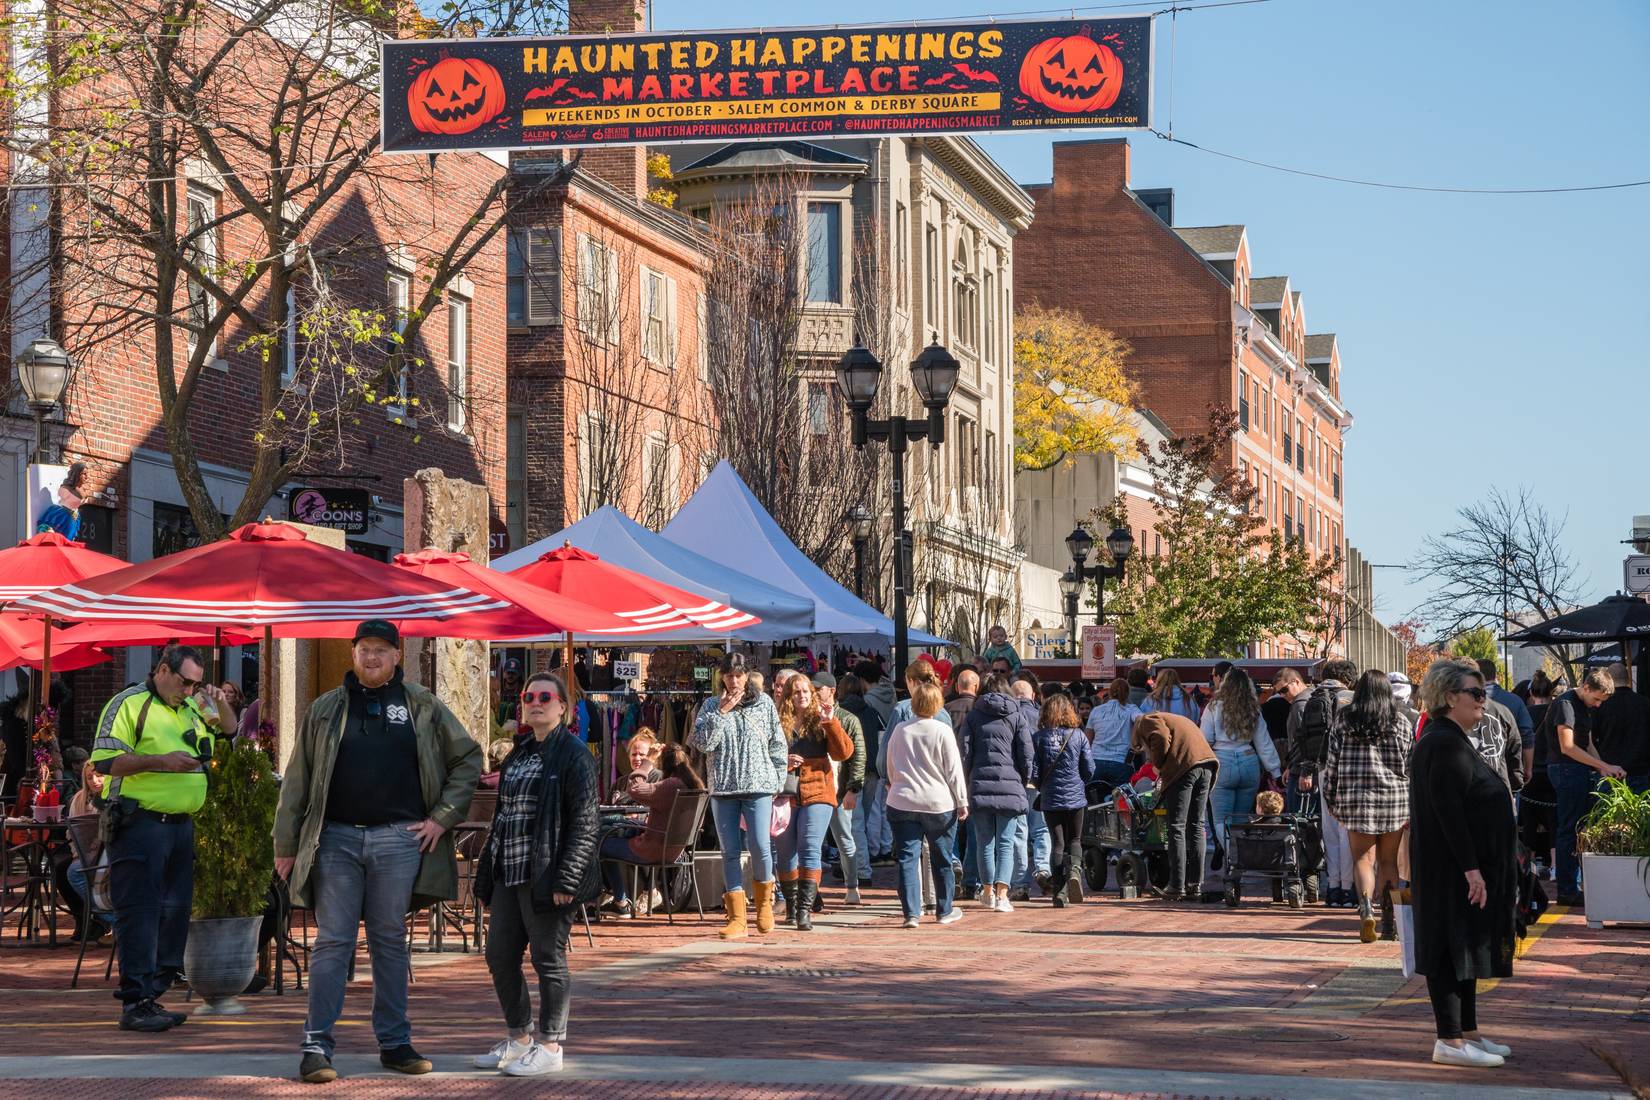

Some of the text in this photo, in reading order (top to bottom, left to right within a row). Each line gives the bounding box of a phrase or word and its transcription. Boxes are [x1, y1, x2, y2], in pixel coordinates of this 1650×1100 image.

[522, 30, 1003, 74] HAUNTED HAPPENINGS
[602, 64, 920, 101] MARKETPLACE
[546, 95, 979, 122] WEEKENDS IN OCTOBER SALEM COMMON & DERBY SQUARE
[635, 115, 1001, 138] HAUNTEDHAPPENINGSMARKETPLACE.COM @HAUNTEDHAPPENINGSMARKET
[312, 511, 363, 521] COON'S
[1027, 634, 1066, 646] Salem
[1035, 646, 1056, 658] Fiv
[616, 667, 637, 677] $25
